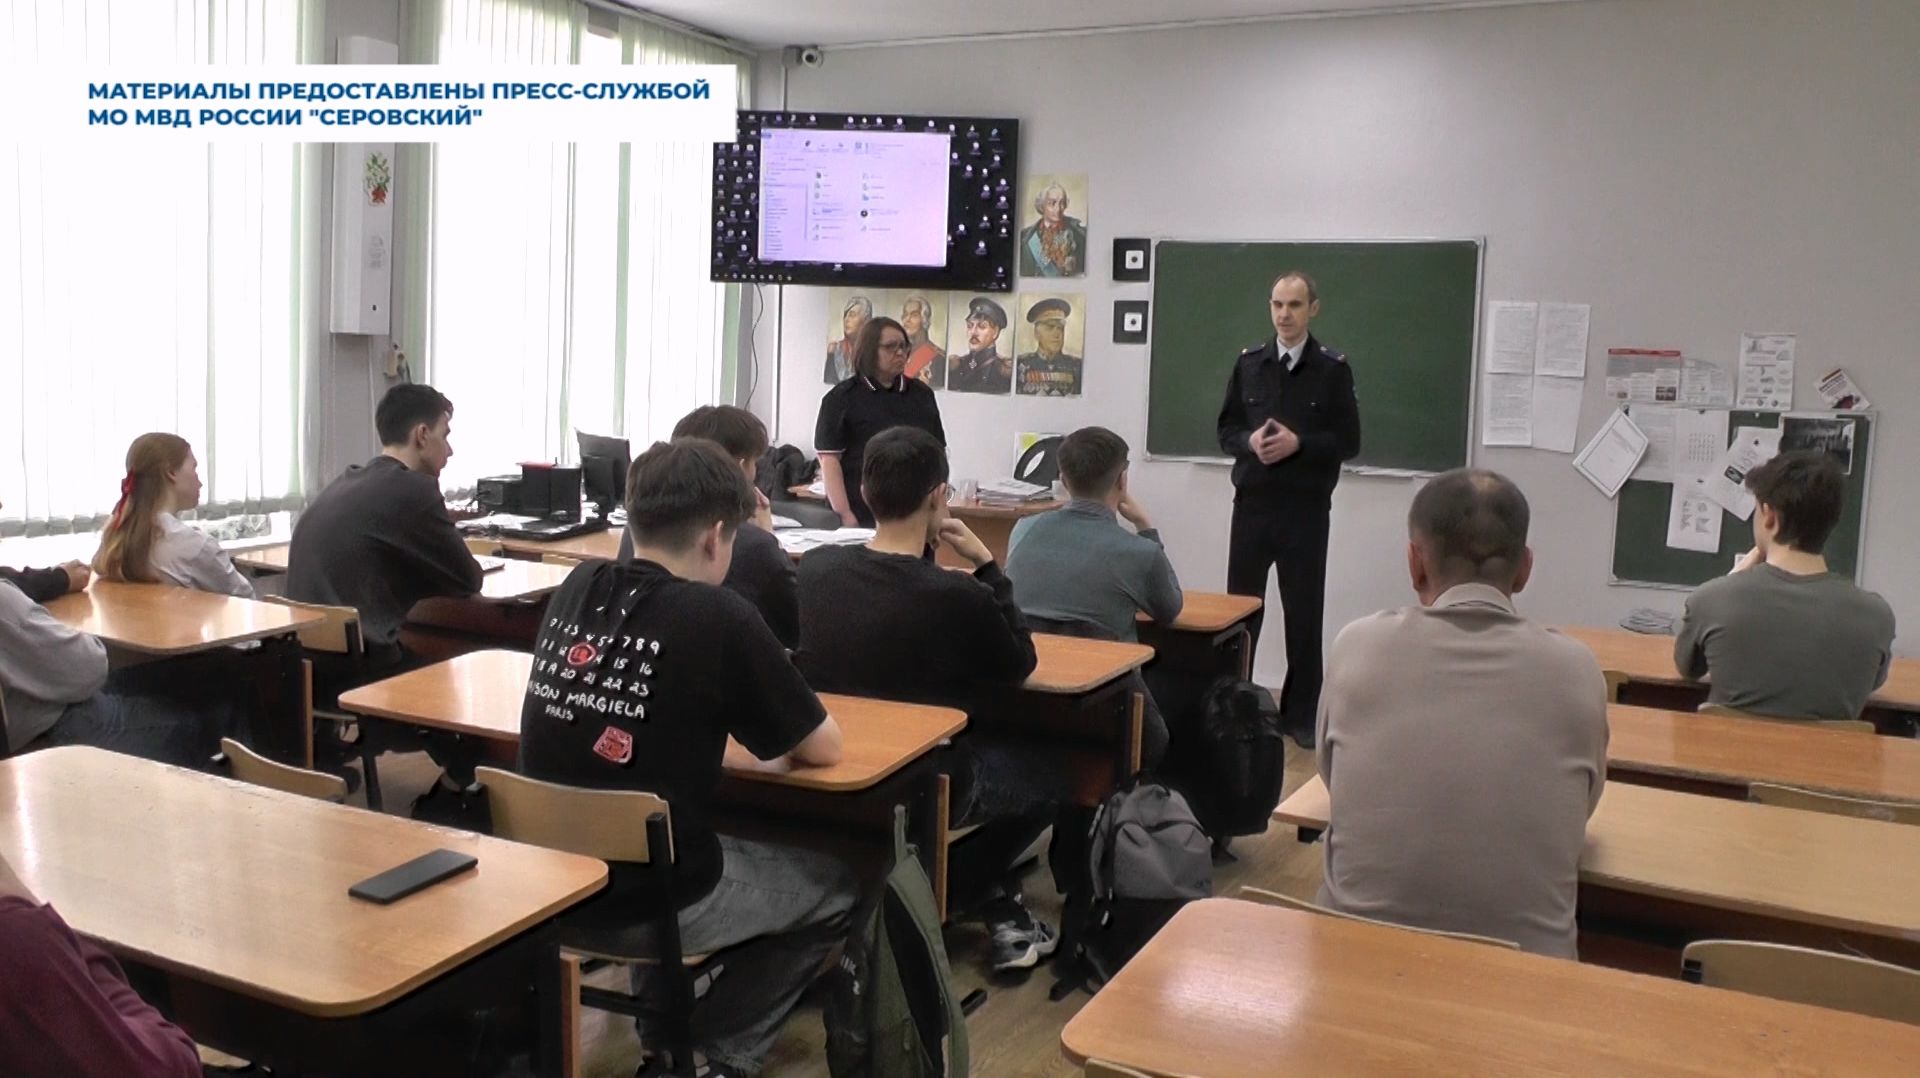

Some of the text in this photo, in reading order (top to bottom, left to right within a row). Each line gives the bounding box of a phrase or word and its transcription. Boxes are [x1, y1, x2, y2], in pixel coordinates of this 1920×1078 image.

[622, 635, 632, 648] 7
[635, 637, 646, 651] 8
[649, 640, 660, 655] 9
[613, 656, 628, 669] 15
[639, 662, 653, 676] 16
[545, 704, 574, 721] PARIS
[565, 691, 645, 719] MARGIELA
